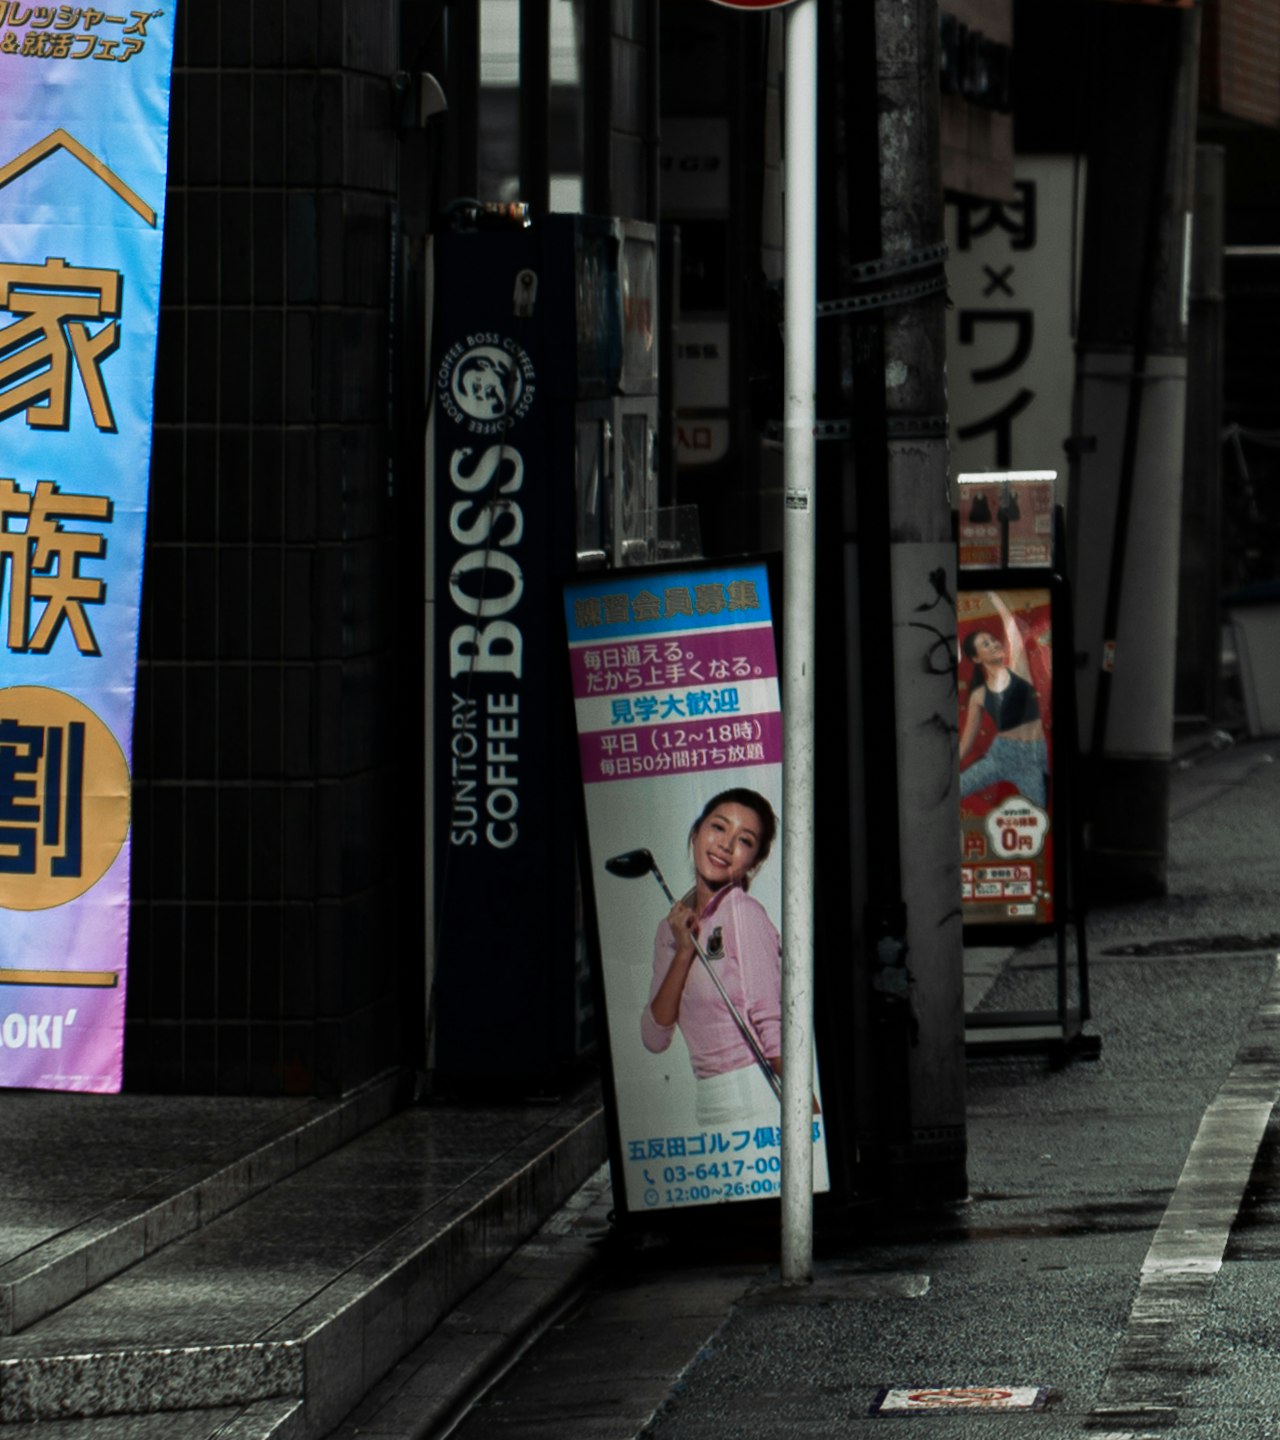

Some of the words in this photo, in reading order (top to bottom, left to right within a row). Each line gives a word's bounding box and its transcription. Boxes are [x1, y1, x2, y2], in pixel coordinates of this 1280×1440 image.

[466, 332, 501, 346] BOSS
[502, 337, 536, 380] COFFEE
[437, 341, 466, 389] COFFEE
[448, 443, 525, 681] BOSS
[574, 580, 761, 630] 練習会員募集
[583, 642, 694, 670] 毎日通える。
[586, 656, 763, 693] だから上手くなる。
[610, 687, 741, 726] 見学大歓迎
[451, 691, 479, 847] SUNTORY
[485, 692, 520, 850] COFFEE
[600, 742, 766, 776] 毎日50分間打ち放題
